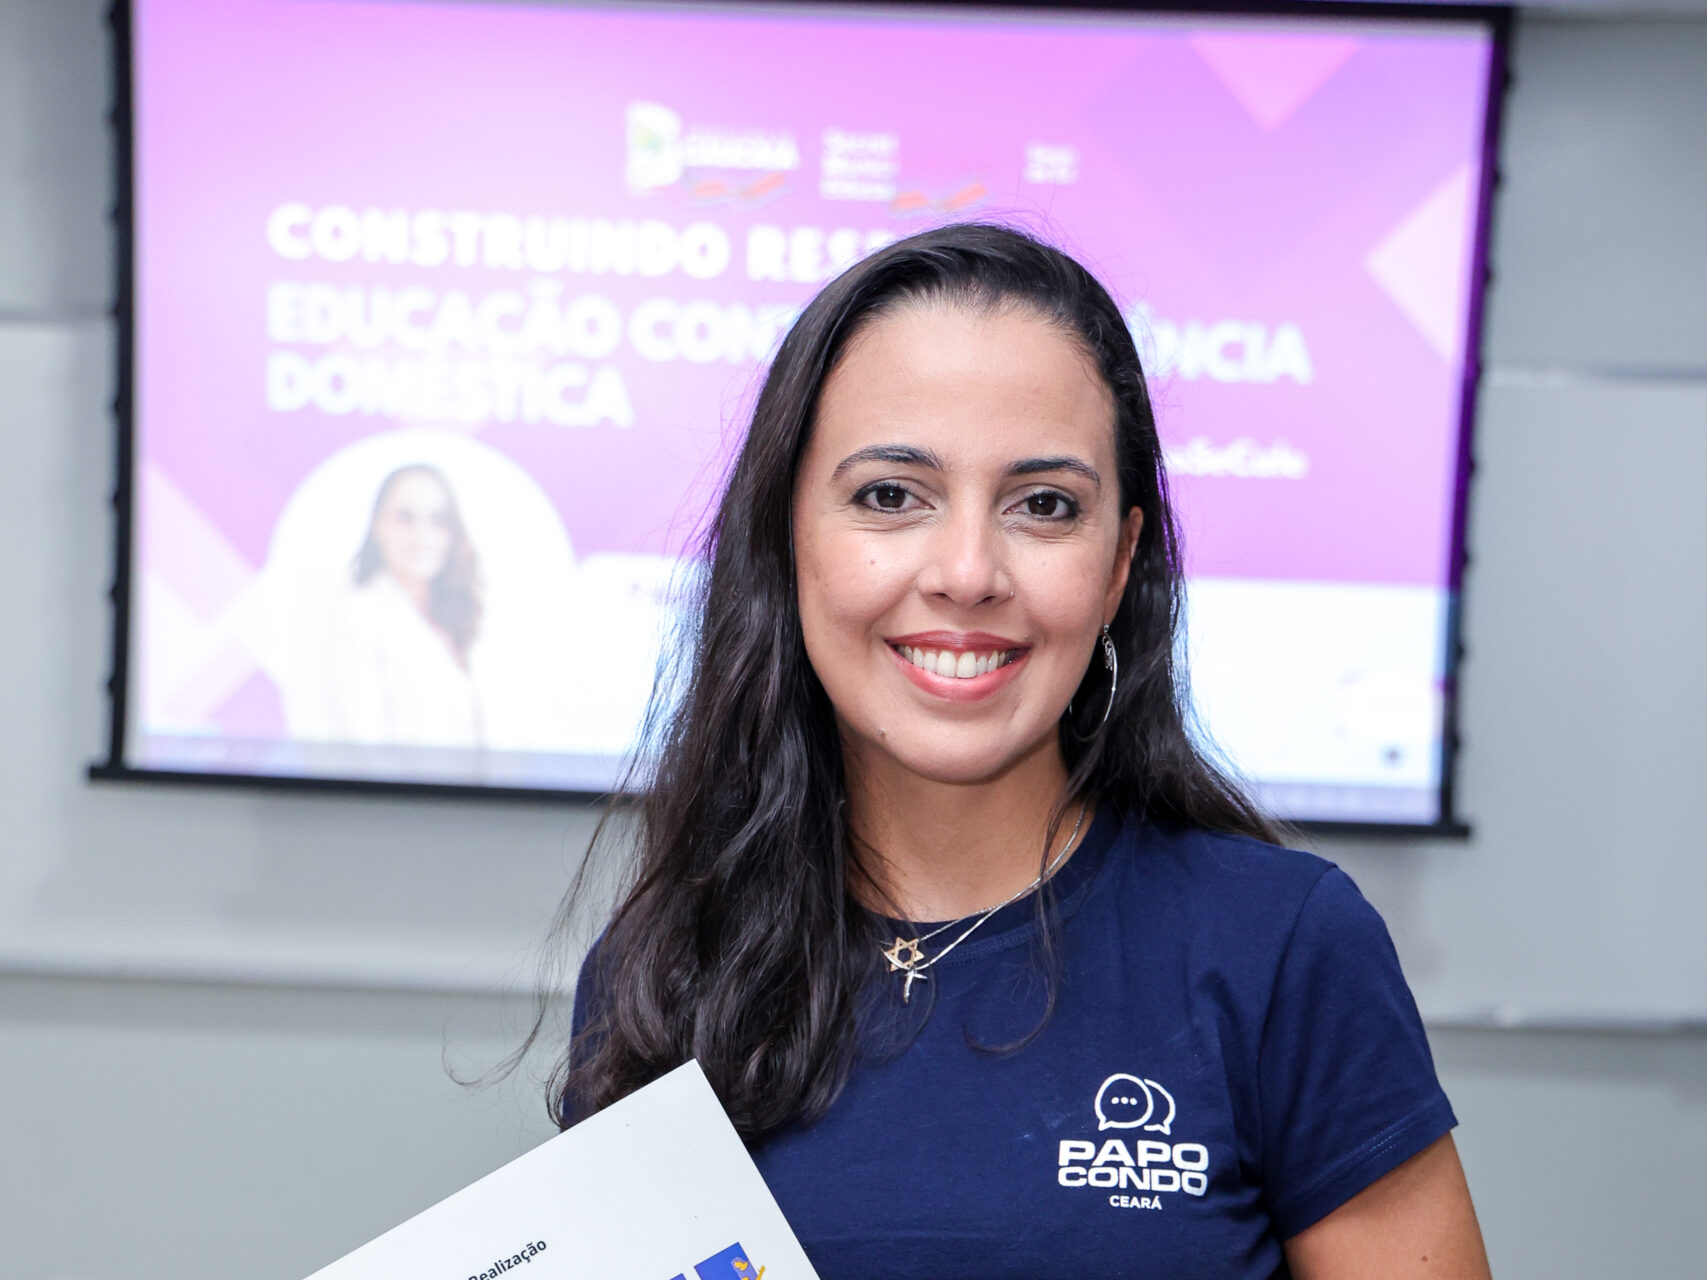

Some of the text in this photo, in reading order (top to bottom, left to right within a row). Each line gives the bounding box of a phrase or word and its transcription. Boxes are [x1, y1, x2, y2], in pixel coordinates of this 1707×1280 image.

[266, 203, 731, 280] CONSTRUINDO
[266, 277, 622, 361] EDUCAÇÃO
[1058, 1139, 1209, 1172] PAPO
[1058, 1166, 1208, 1197] CONDO
[1109, 1195, 1162, 1210] CEARÁ
